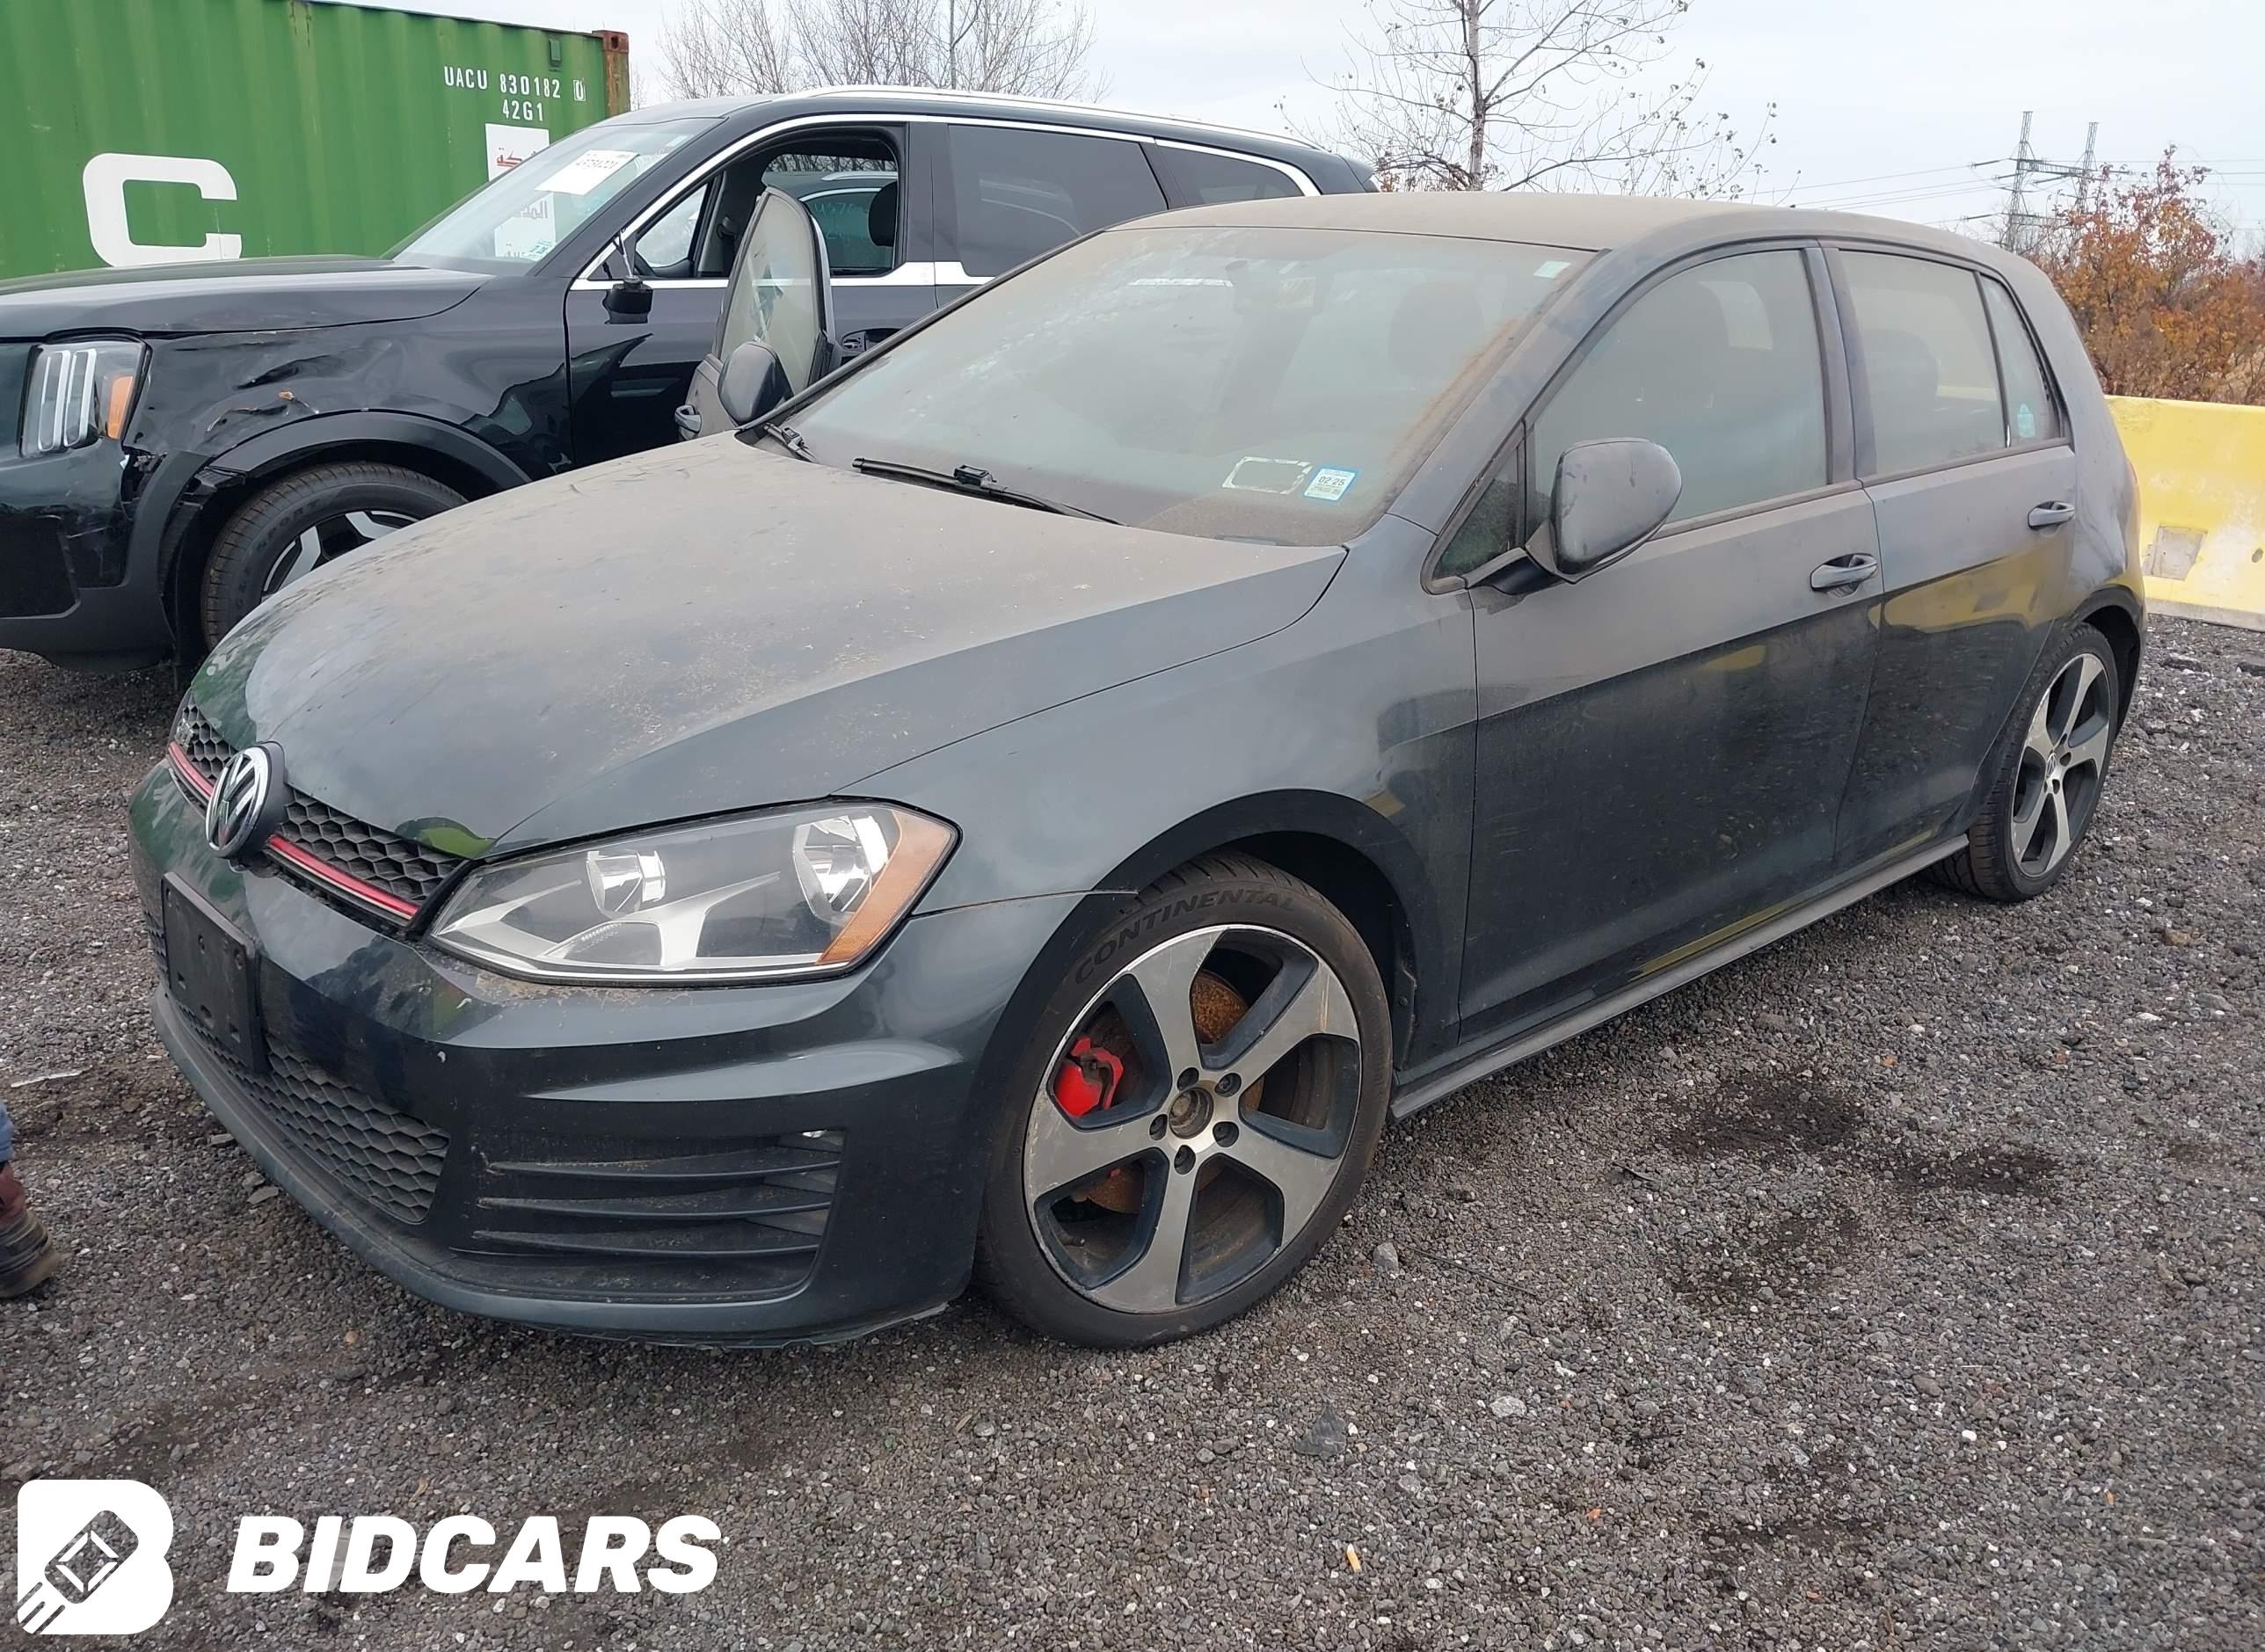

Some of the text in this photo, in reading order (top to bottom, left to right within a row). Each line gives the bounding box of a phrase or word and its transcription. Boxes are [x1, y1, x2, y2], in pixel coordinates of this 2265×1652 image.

[444, 66, 488, 90] UACU
[499, 74, 561, 98] 830182
[502, 99, 543, 121] 42G1
[83, 153, 242, 267] C
[1074, 889, 1297, 985] CONTINENTAL
